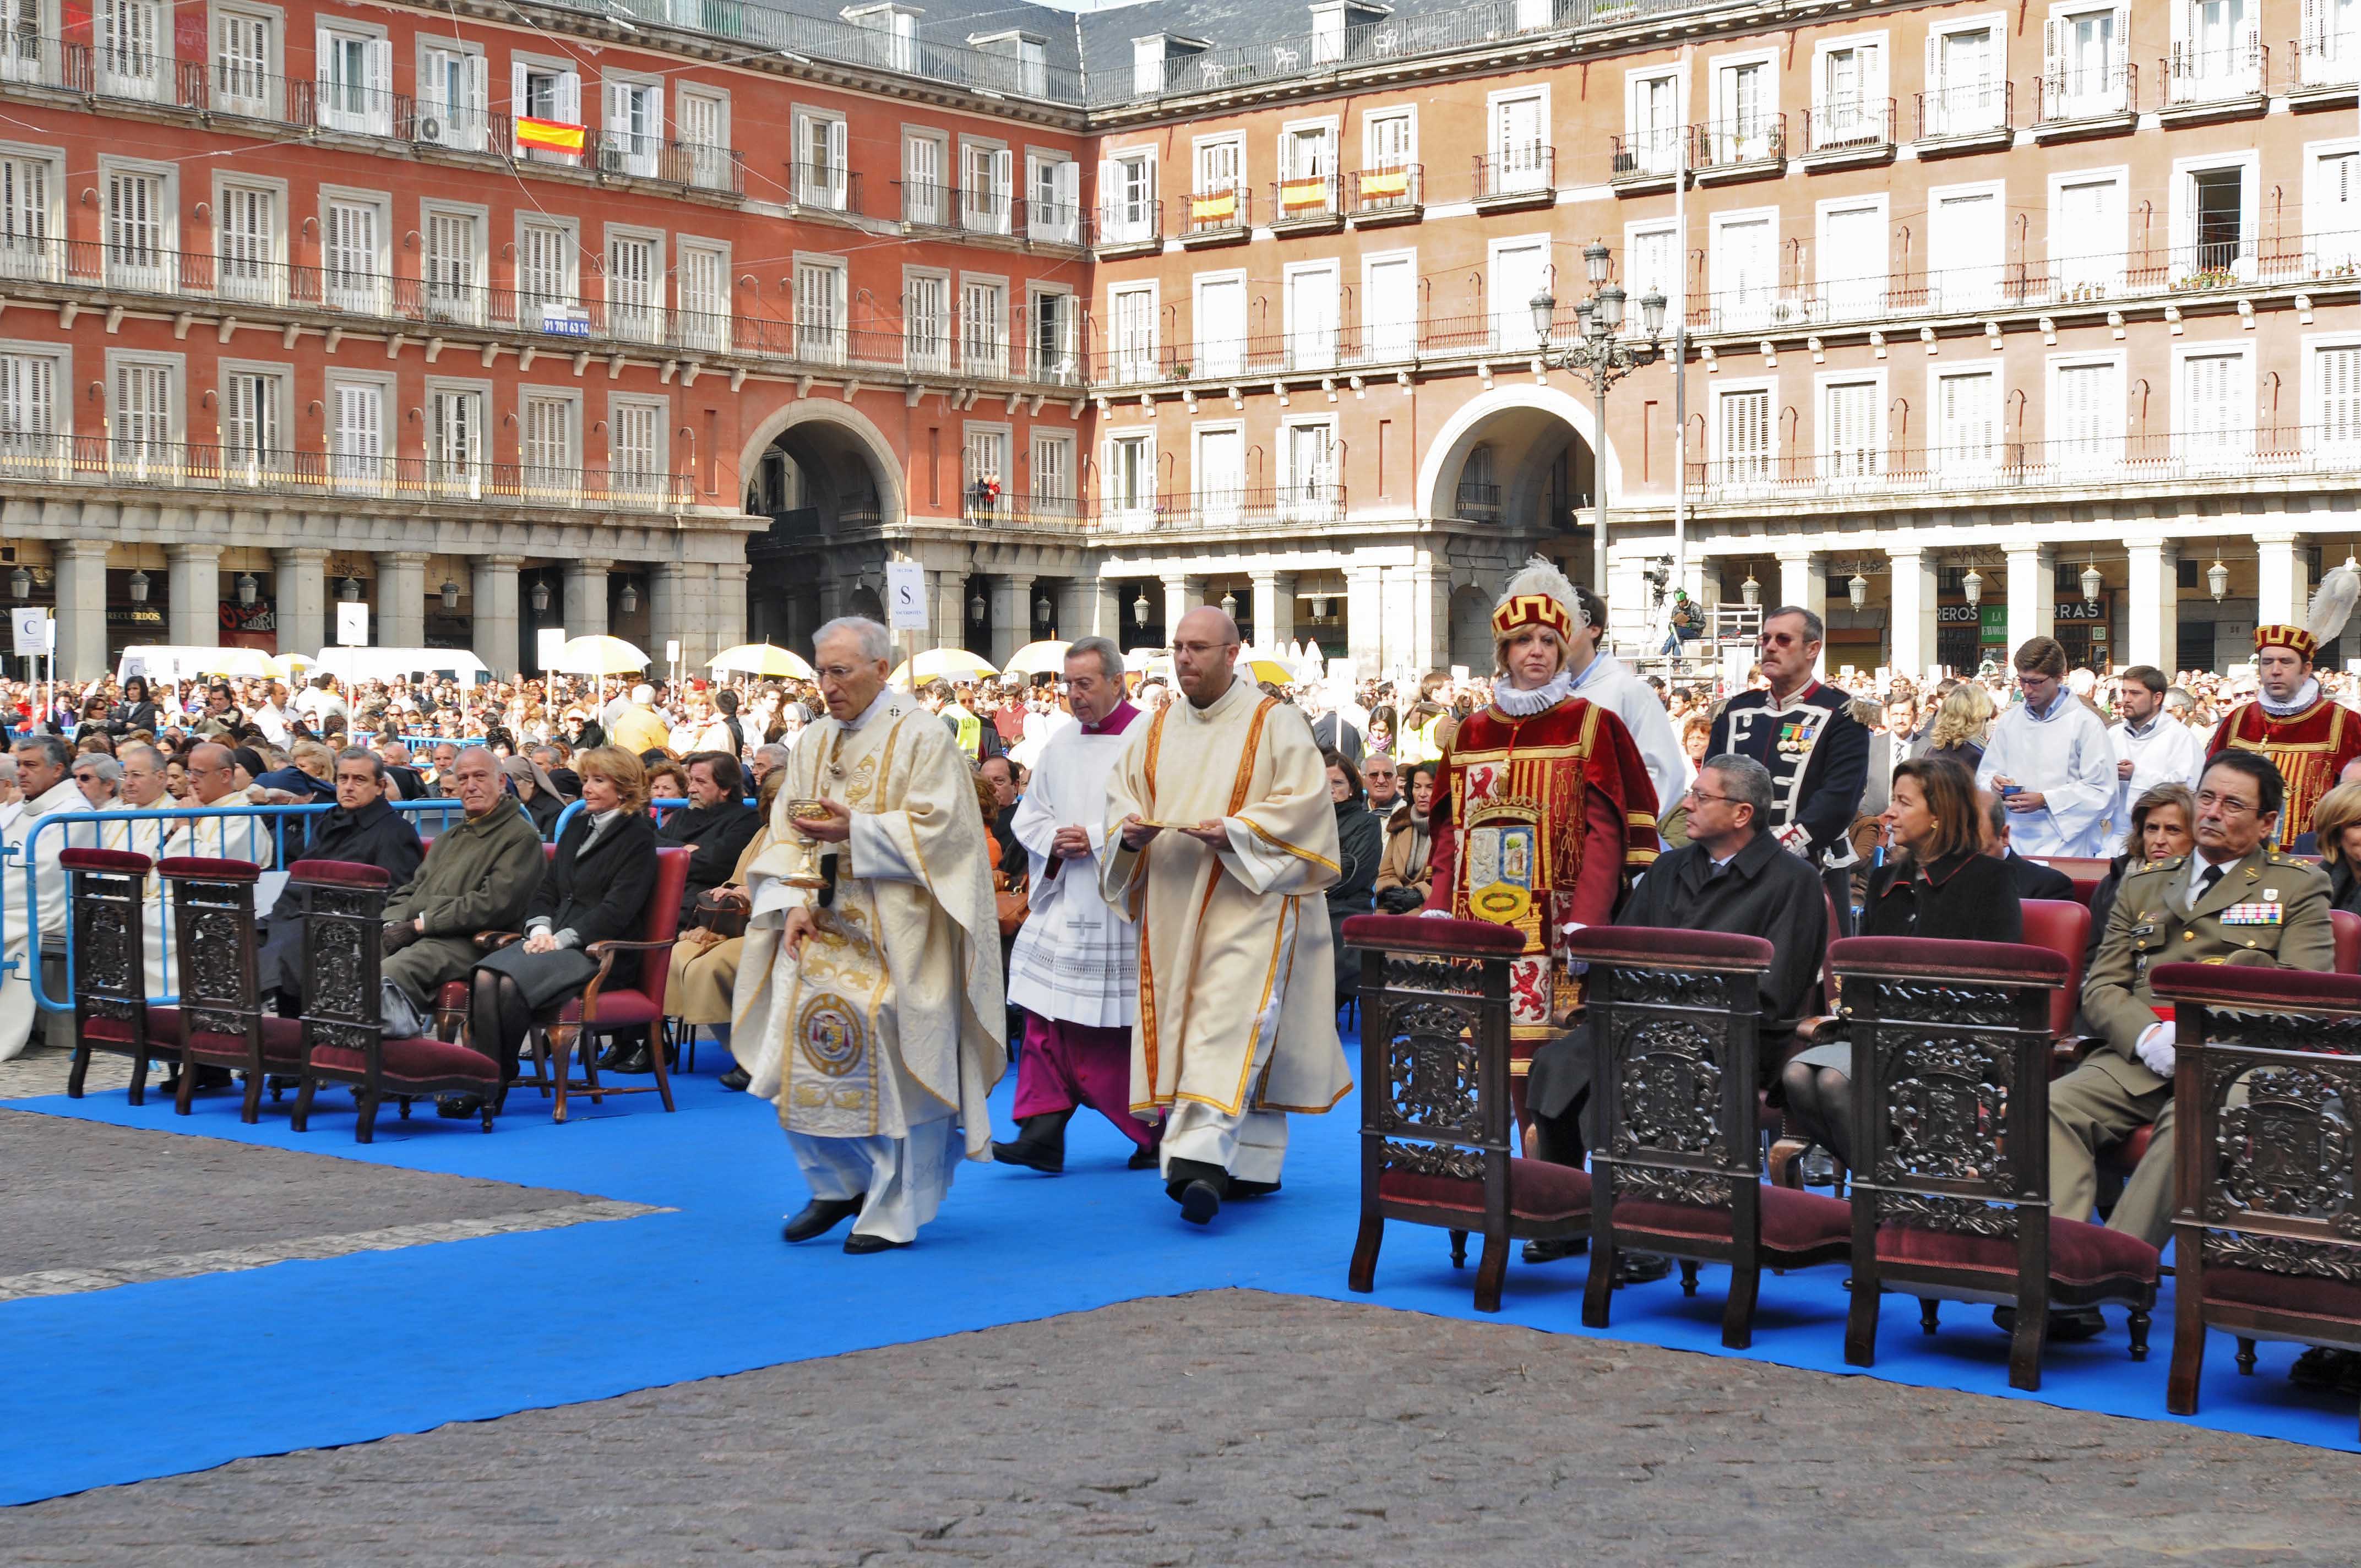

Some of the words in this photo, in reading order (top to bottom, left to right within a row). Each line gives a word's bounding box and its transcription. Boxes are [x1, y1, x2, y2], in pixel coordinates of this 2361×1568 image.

[545, 320, 553, 331] 91
[555, 320, 568, 332] 781
[569, 322, 579, 333] 63
[580, 323, 589, 334] 14
[107, 612, 161, 620] RECUERDOS
[1992, 612, 2002, 622] LA
[24, 620, 37, 635] C
[2095, 629, 2104, 638] 25
